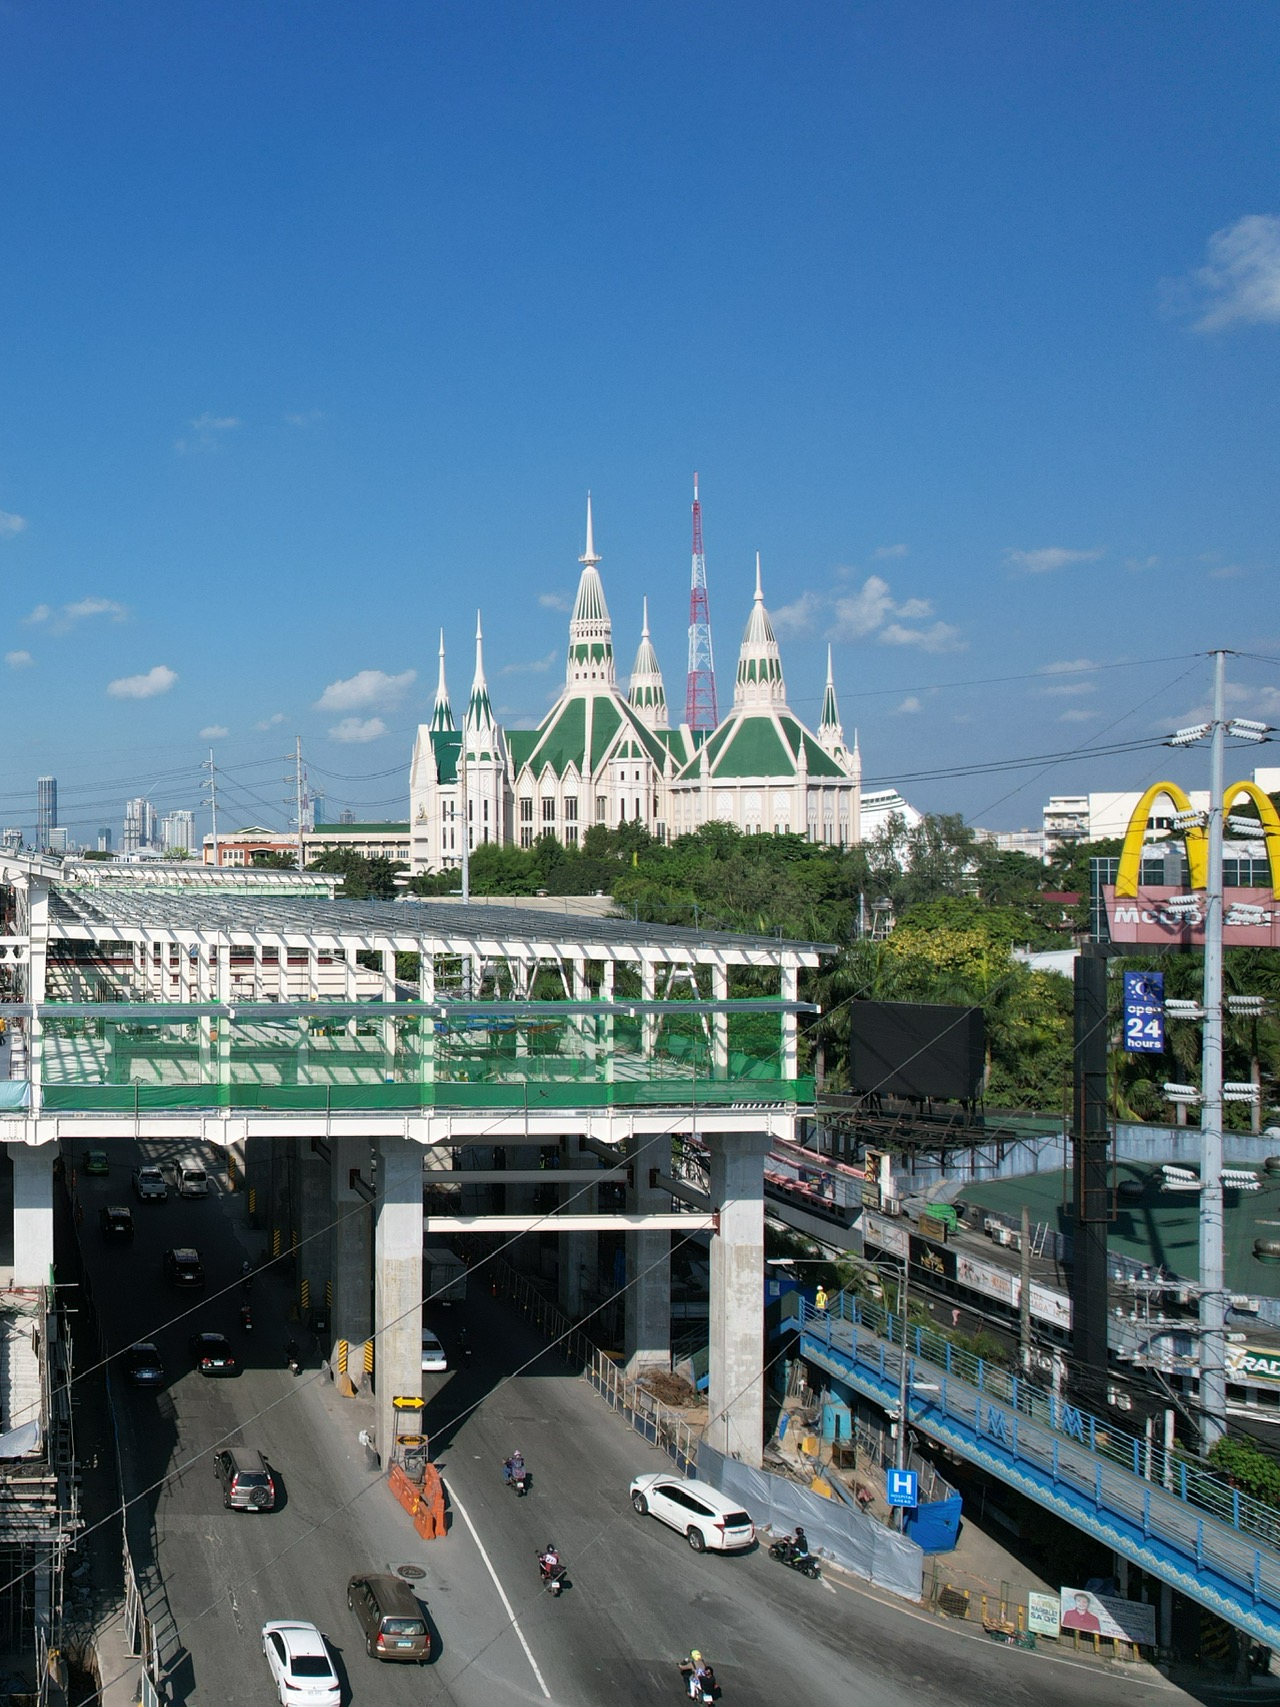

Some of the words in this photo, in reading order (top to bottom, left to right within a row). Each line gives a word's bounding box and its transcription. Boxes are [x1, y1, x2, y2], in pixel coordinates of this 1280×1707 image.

[1127, 1017, 1161, 1038] 24
[1127, 1038, 1161, 1049] hours
[893, 1473, 912, 1495] H
